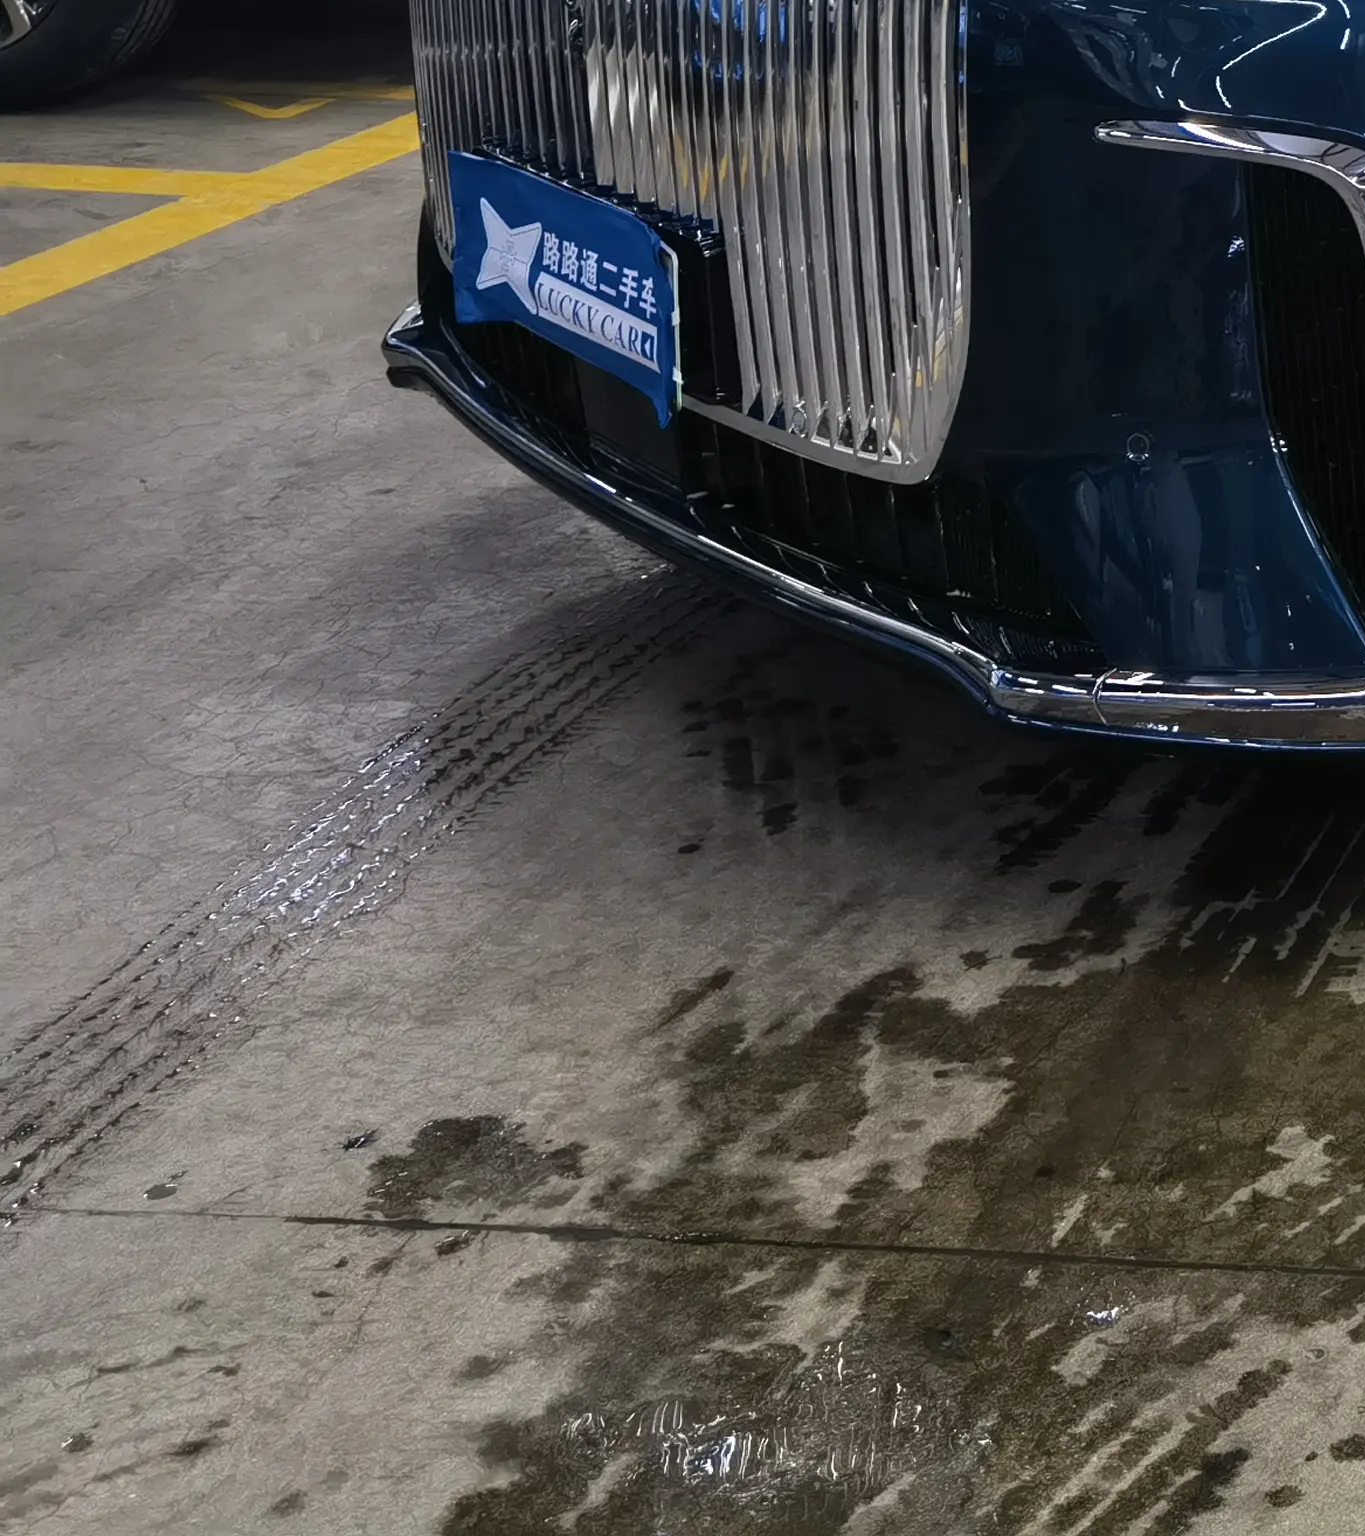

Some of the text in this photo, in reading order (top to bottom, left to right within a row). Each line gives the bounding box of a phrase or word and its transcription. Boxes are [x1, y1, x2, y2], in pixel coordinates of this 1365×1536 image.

[542, 231, 657, 319] 路路通二手车
[537, 283, 640, 355] LUCKY CAR
